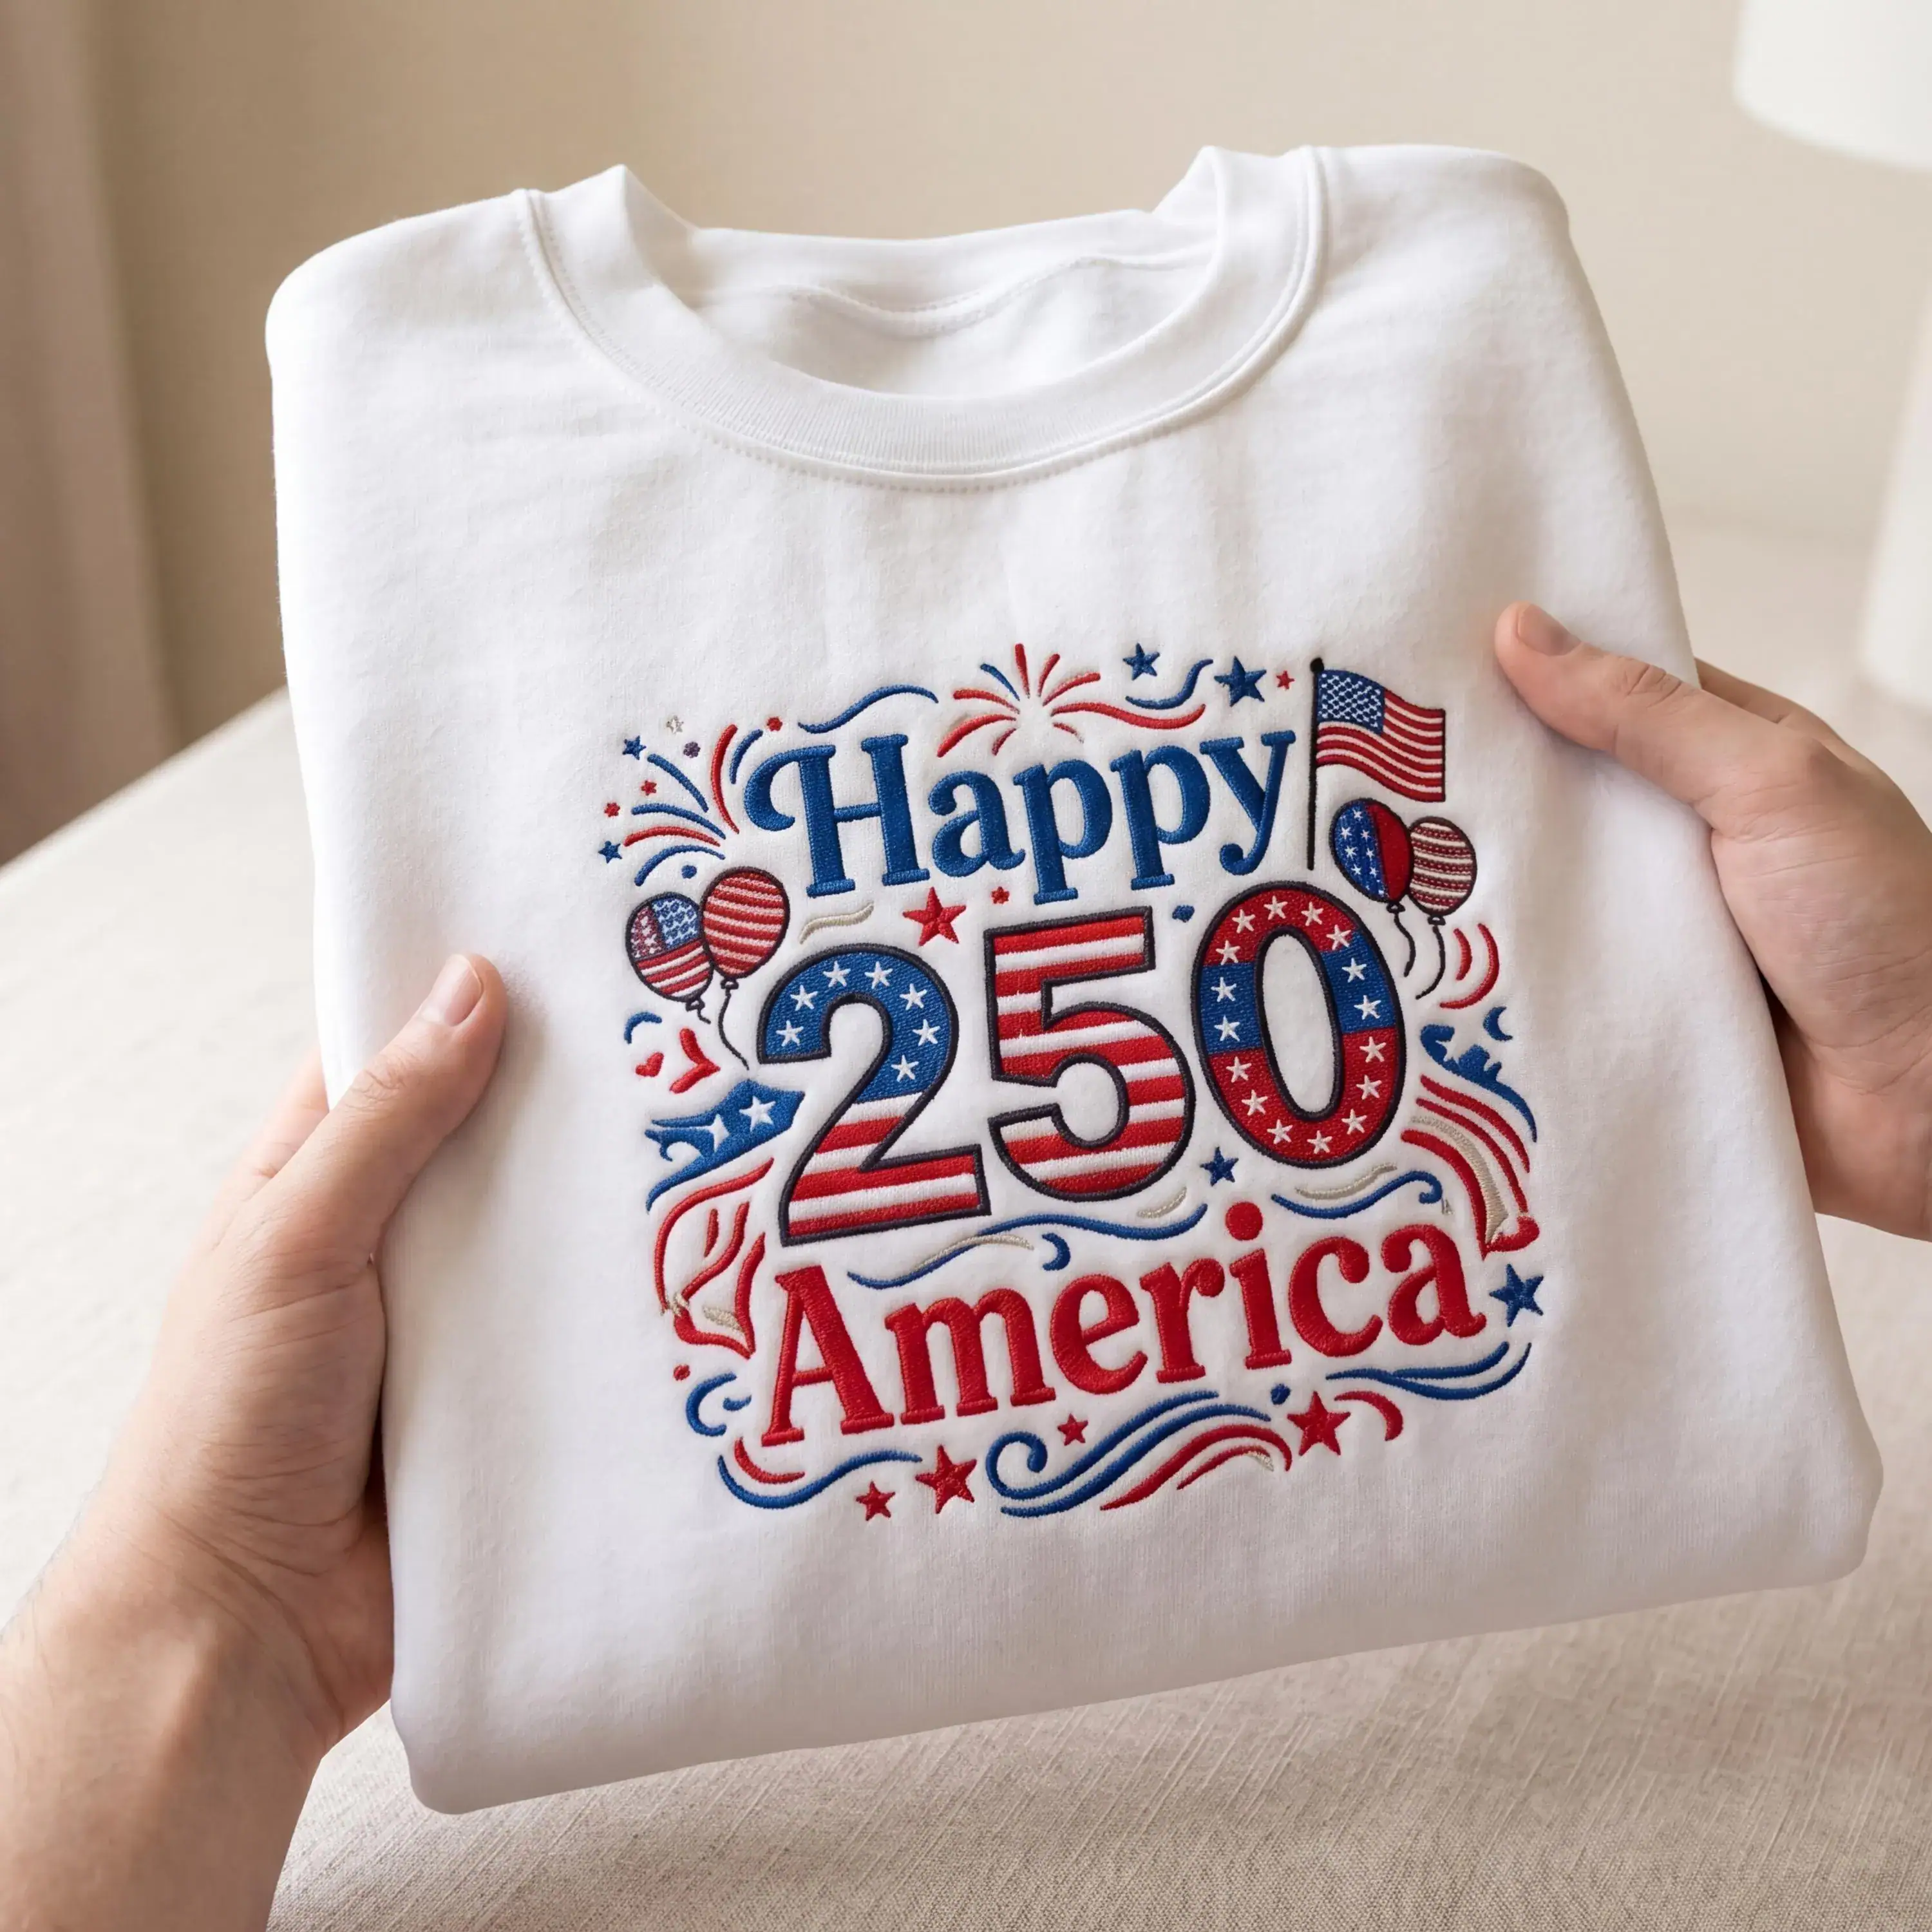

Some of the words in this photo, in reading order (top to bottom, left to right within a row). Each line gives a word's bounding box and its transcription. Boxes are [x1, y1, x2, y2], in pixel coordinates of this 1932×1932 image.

[744, 730, 1296, 904] Happy
[757, 881, 1406, 1247] 250
[760, 1202, 1486, 1446] America
